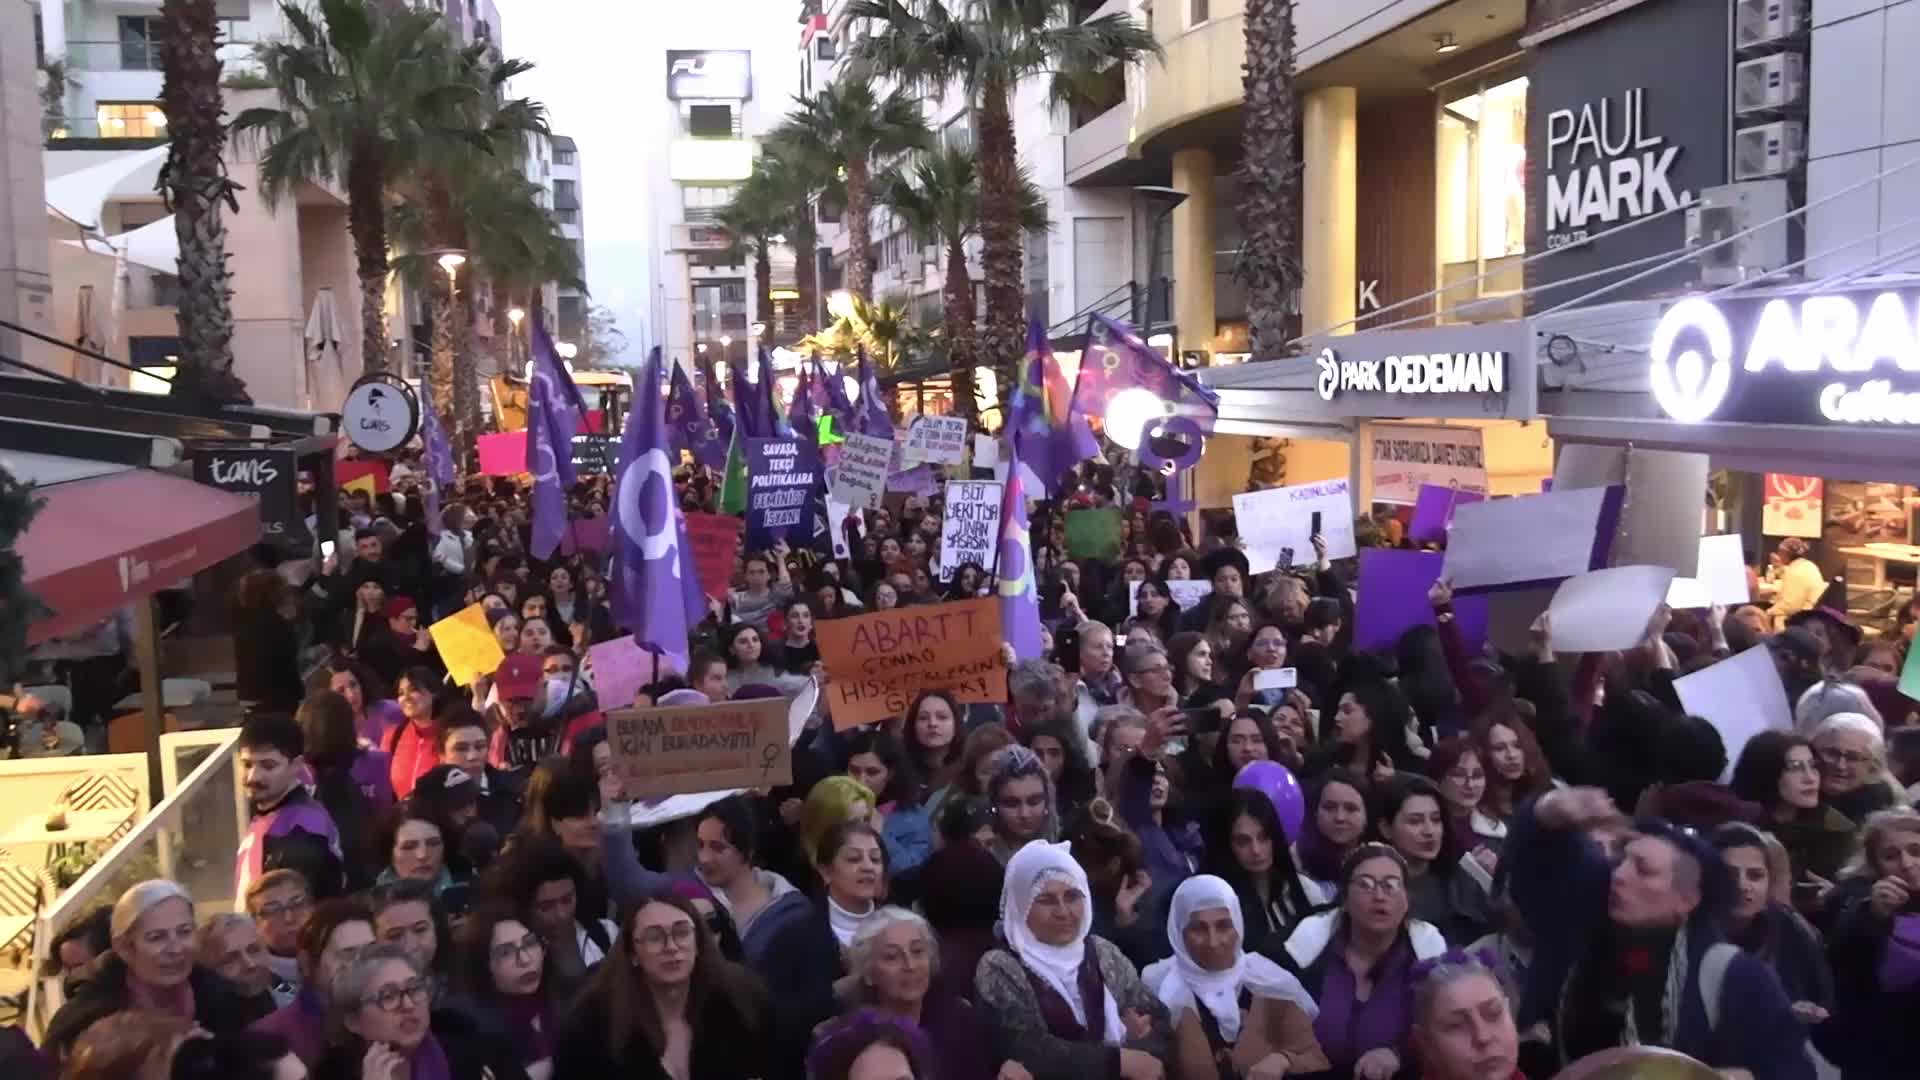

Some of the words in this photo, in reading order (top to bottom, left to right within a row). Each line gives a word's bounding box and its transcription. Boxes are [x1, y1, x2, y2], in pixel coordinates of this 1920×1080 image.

[1548, 87, 1662, 169] PAUL
[1743, 292, 1920, 372] ARA
[1340, 361, 1381, 391] PARK
[1384, 351, 1503, 394] DEDEMAN
[763, 443, 799, 456] SAVAŞA,
[208, 457, 278, 485] tans
[769, 457, 795, 473] TEKÇİ
[752, 472, 814, 488] POLİTİKALARA
